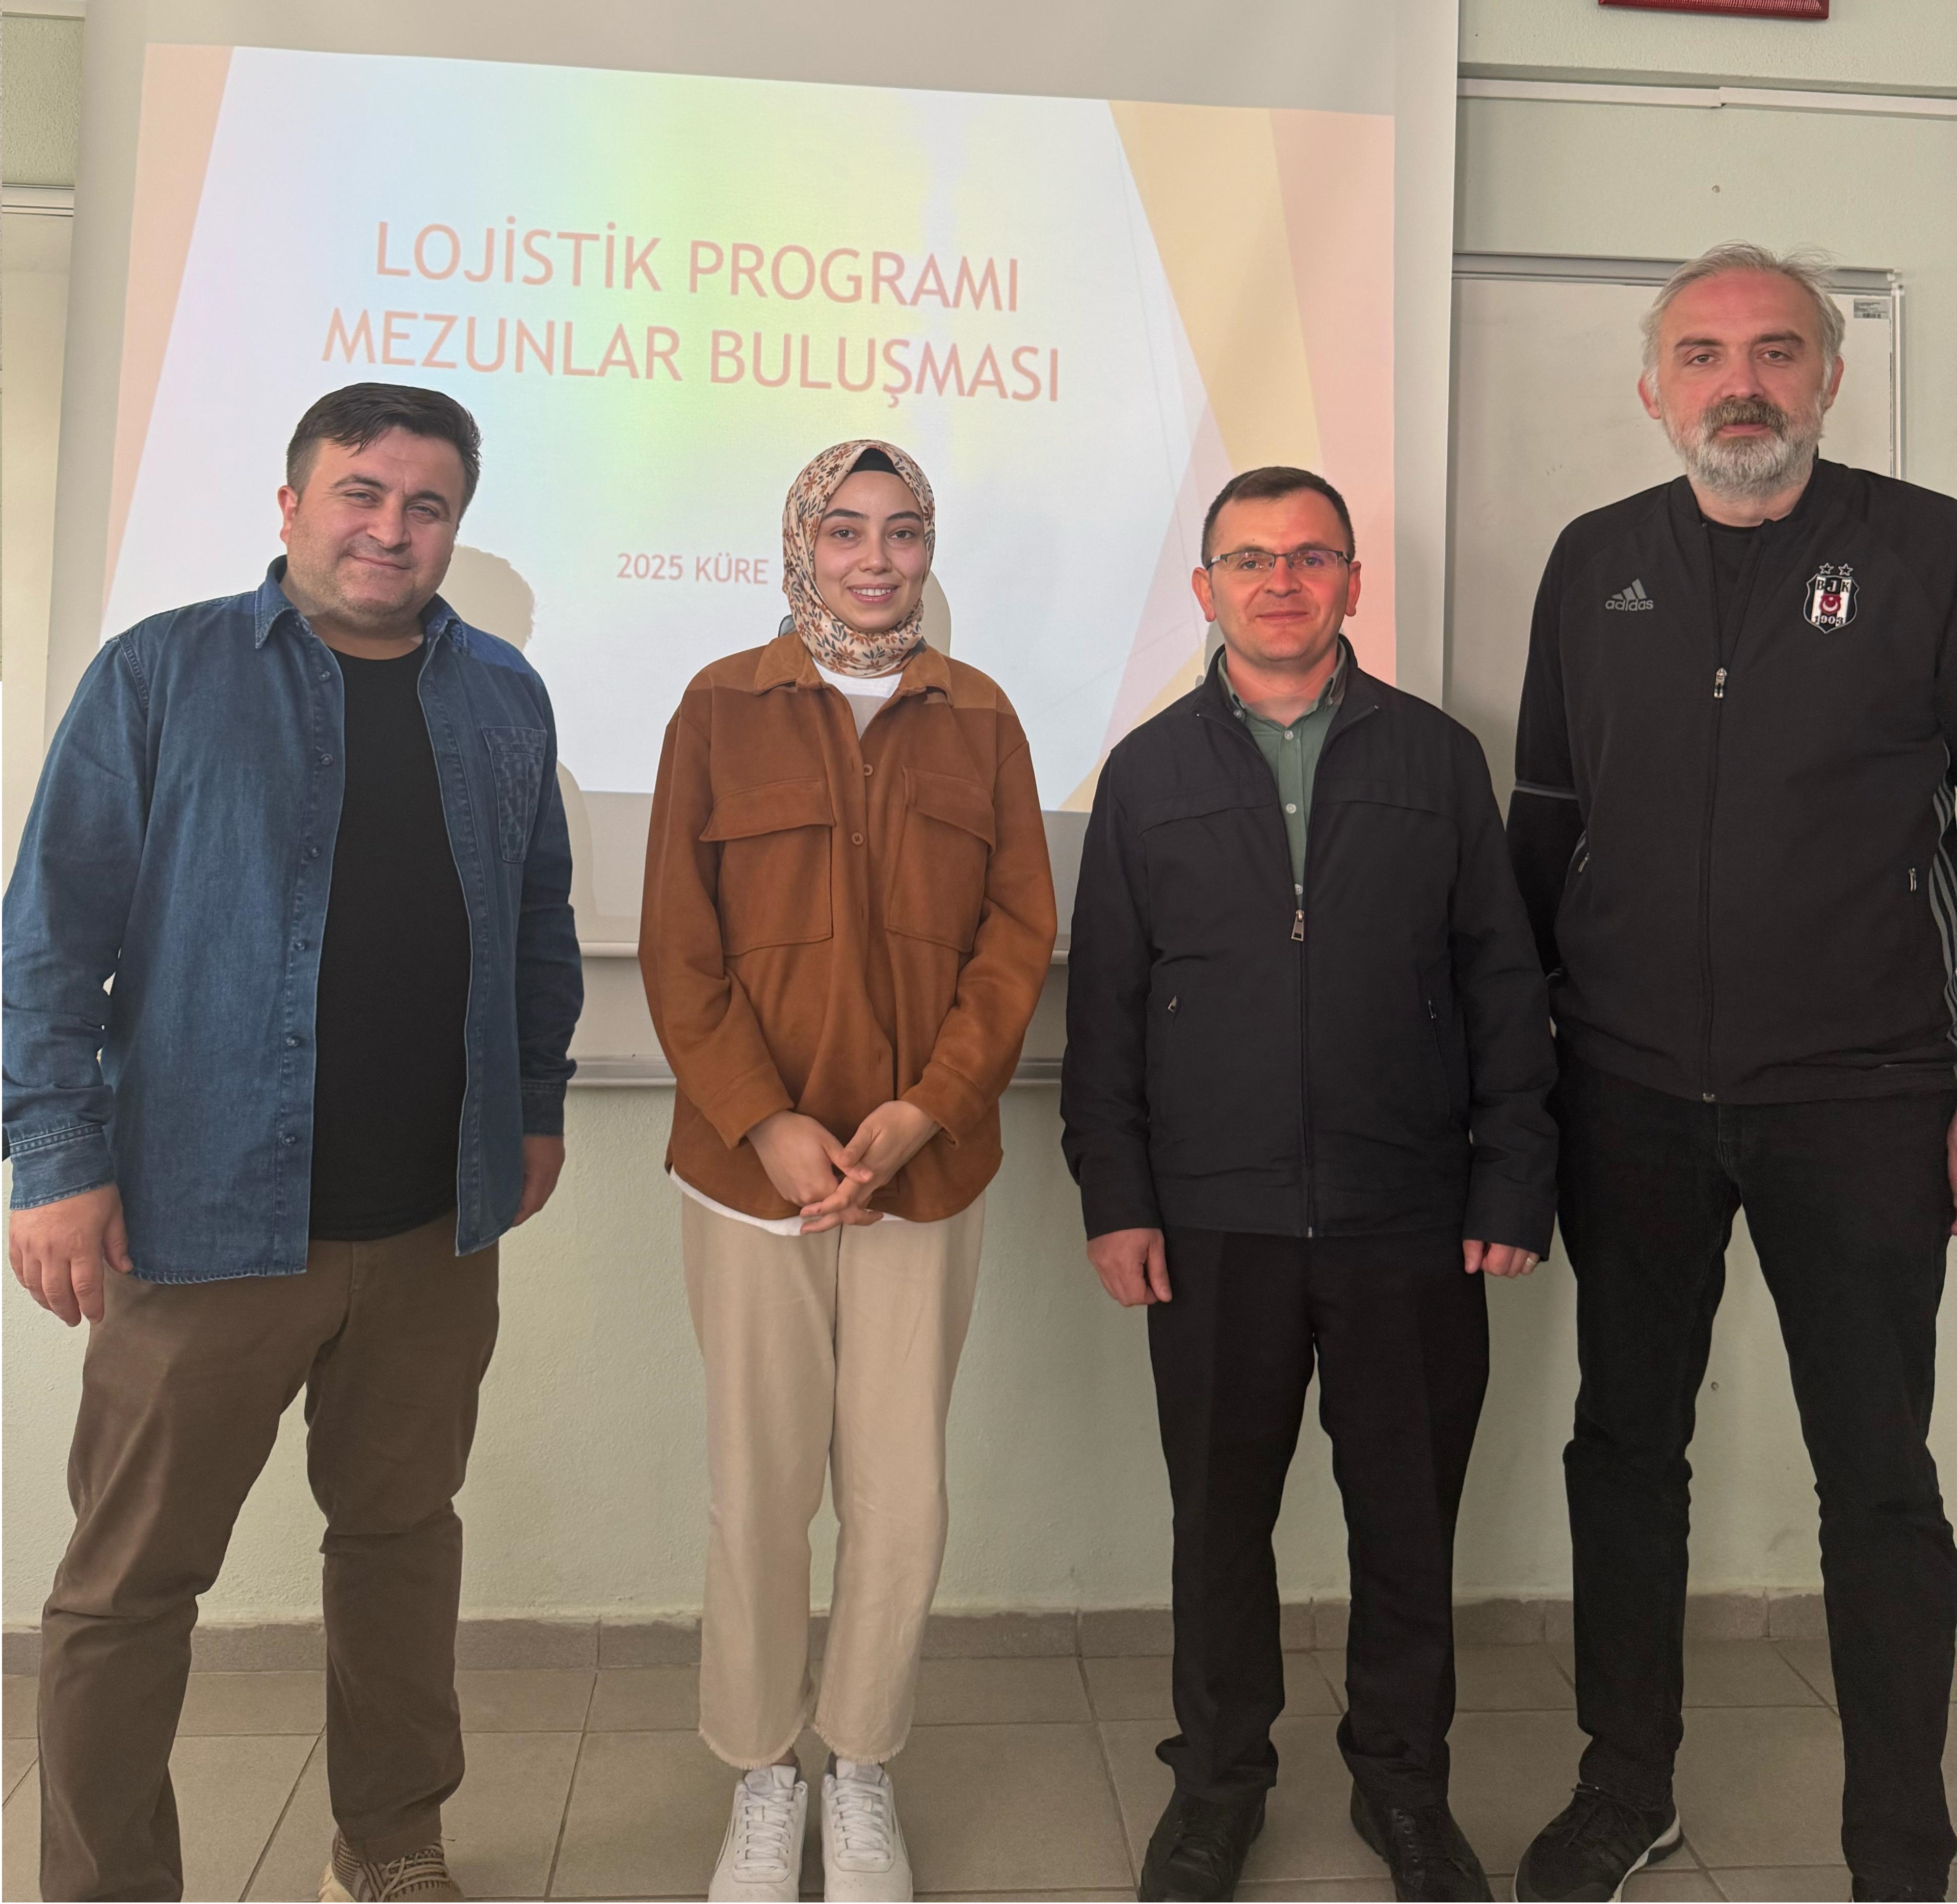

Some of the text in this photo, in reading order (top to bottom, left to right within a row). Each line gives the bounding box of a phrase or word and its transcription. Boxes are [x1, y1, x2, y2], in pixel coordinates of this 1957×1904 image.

[376, 215, 1018, 313] LOJİSTİK PROGRAMI
[322, 308, 1060, 409] MEZUNLAR BULUŞMASI
[617, 552, 769, 585] 2025 KÜRE
[1605, 599, 1654, 611] adidas
[1814, 615, 1844, 625] 1903
